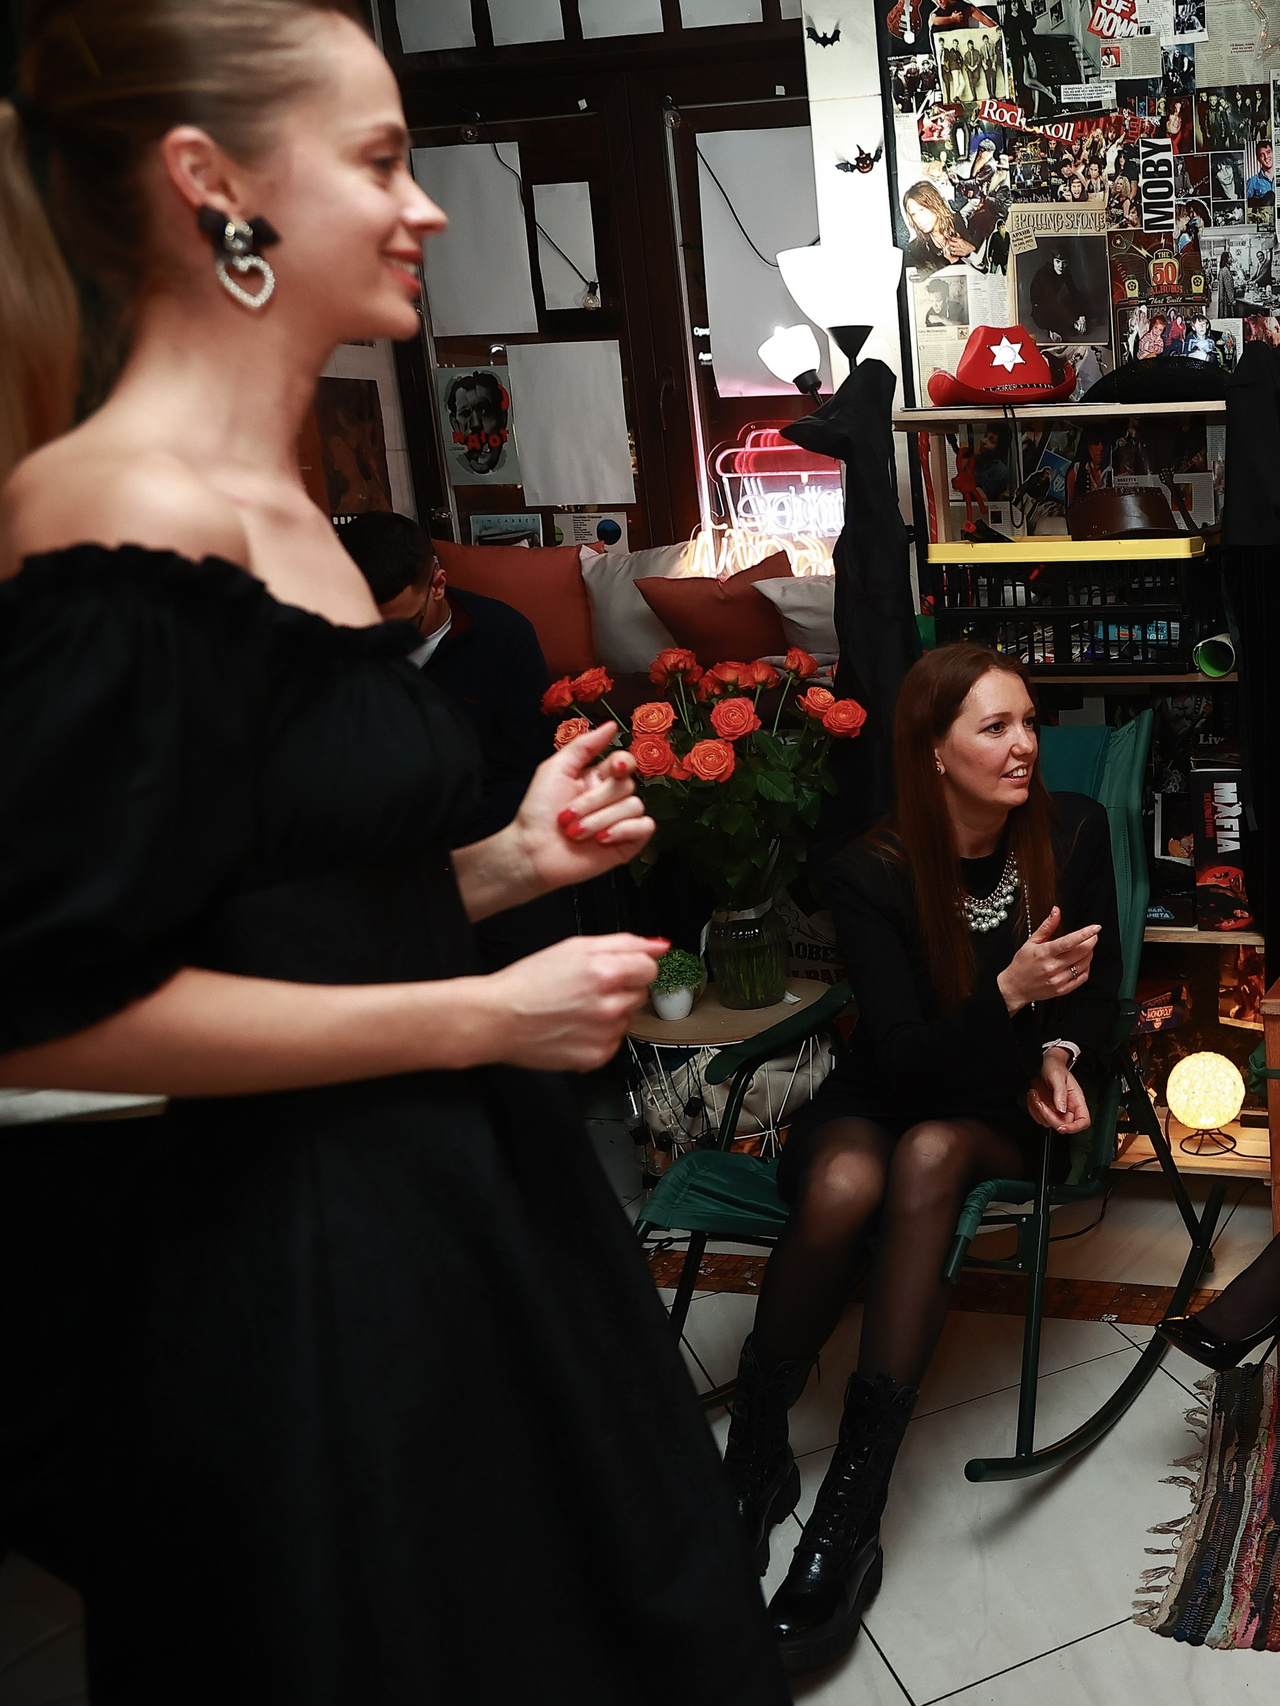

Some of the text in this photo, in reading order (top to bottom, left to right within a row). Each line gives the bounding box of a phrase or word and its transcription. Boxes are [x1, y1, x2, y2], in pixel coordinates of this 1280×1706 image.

[1142, 139, 1176, 231] MOBY
[1153, 262, 1177, 285] 50
[1149, 284, 1183, 295] ALBUMS
[1212, 782, 1242, 854] MAFIA
[1147, 1007, 1172, 1019] MONOPOLY
